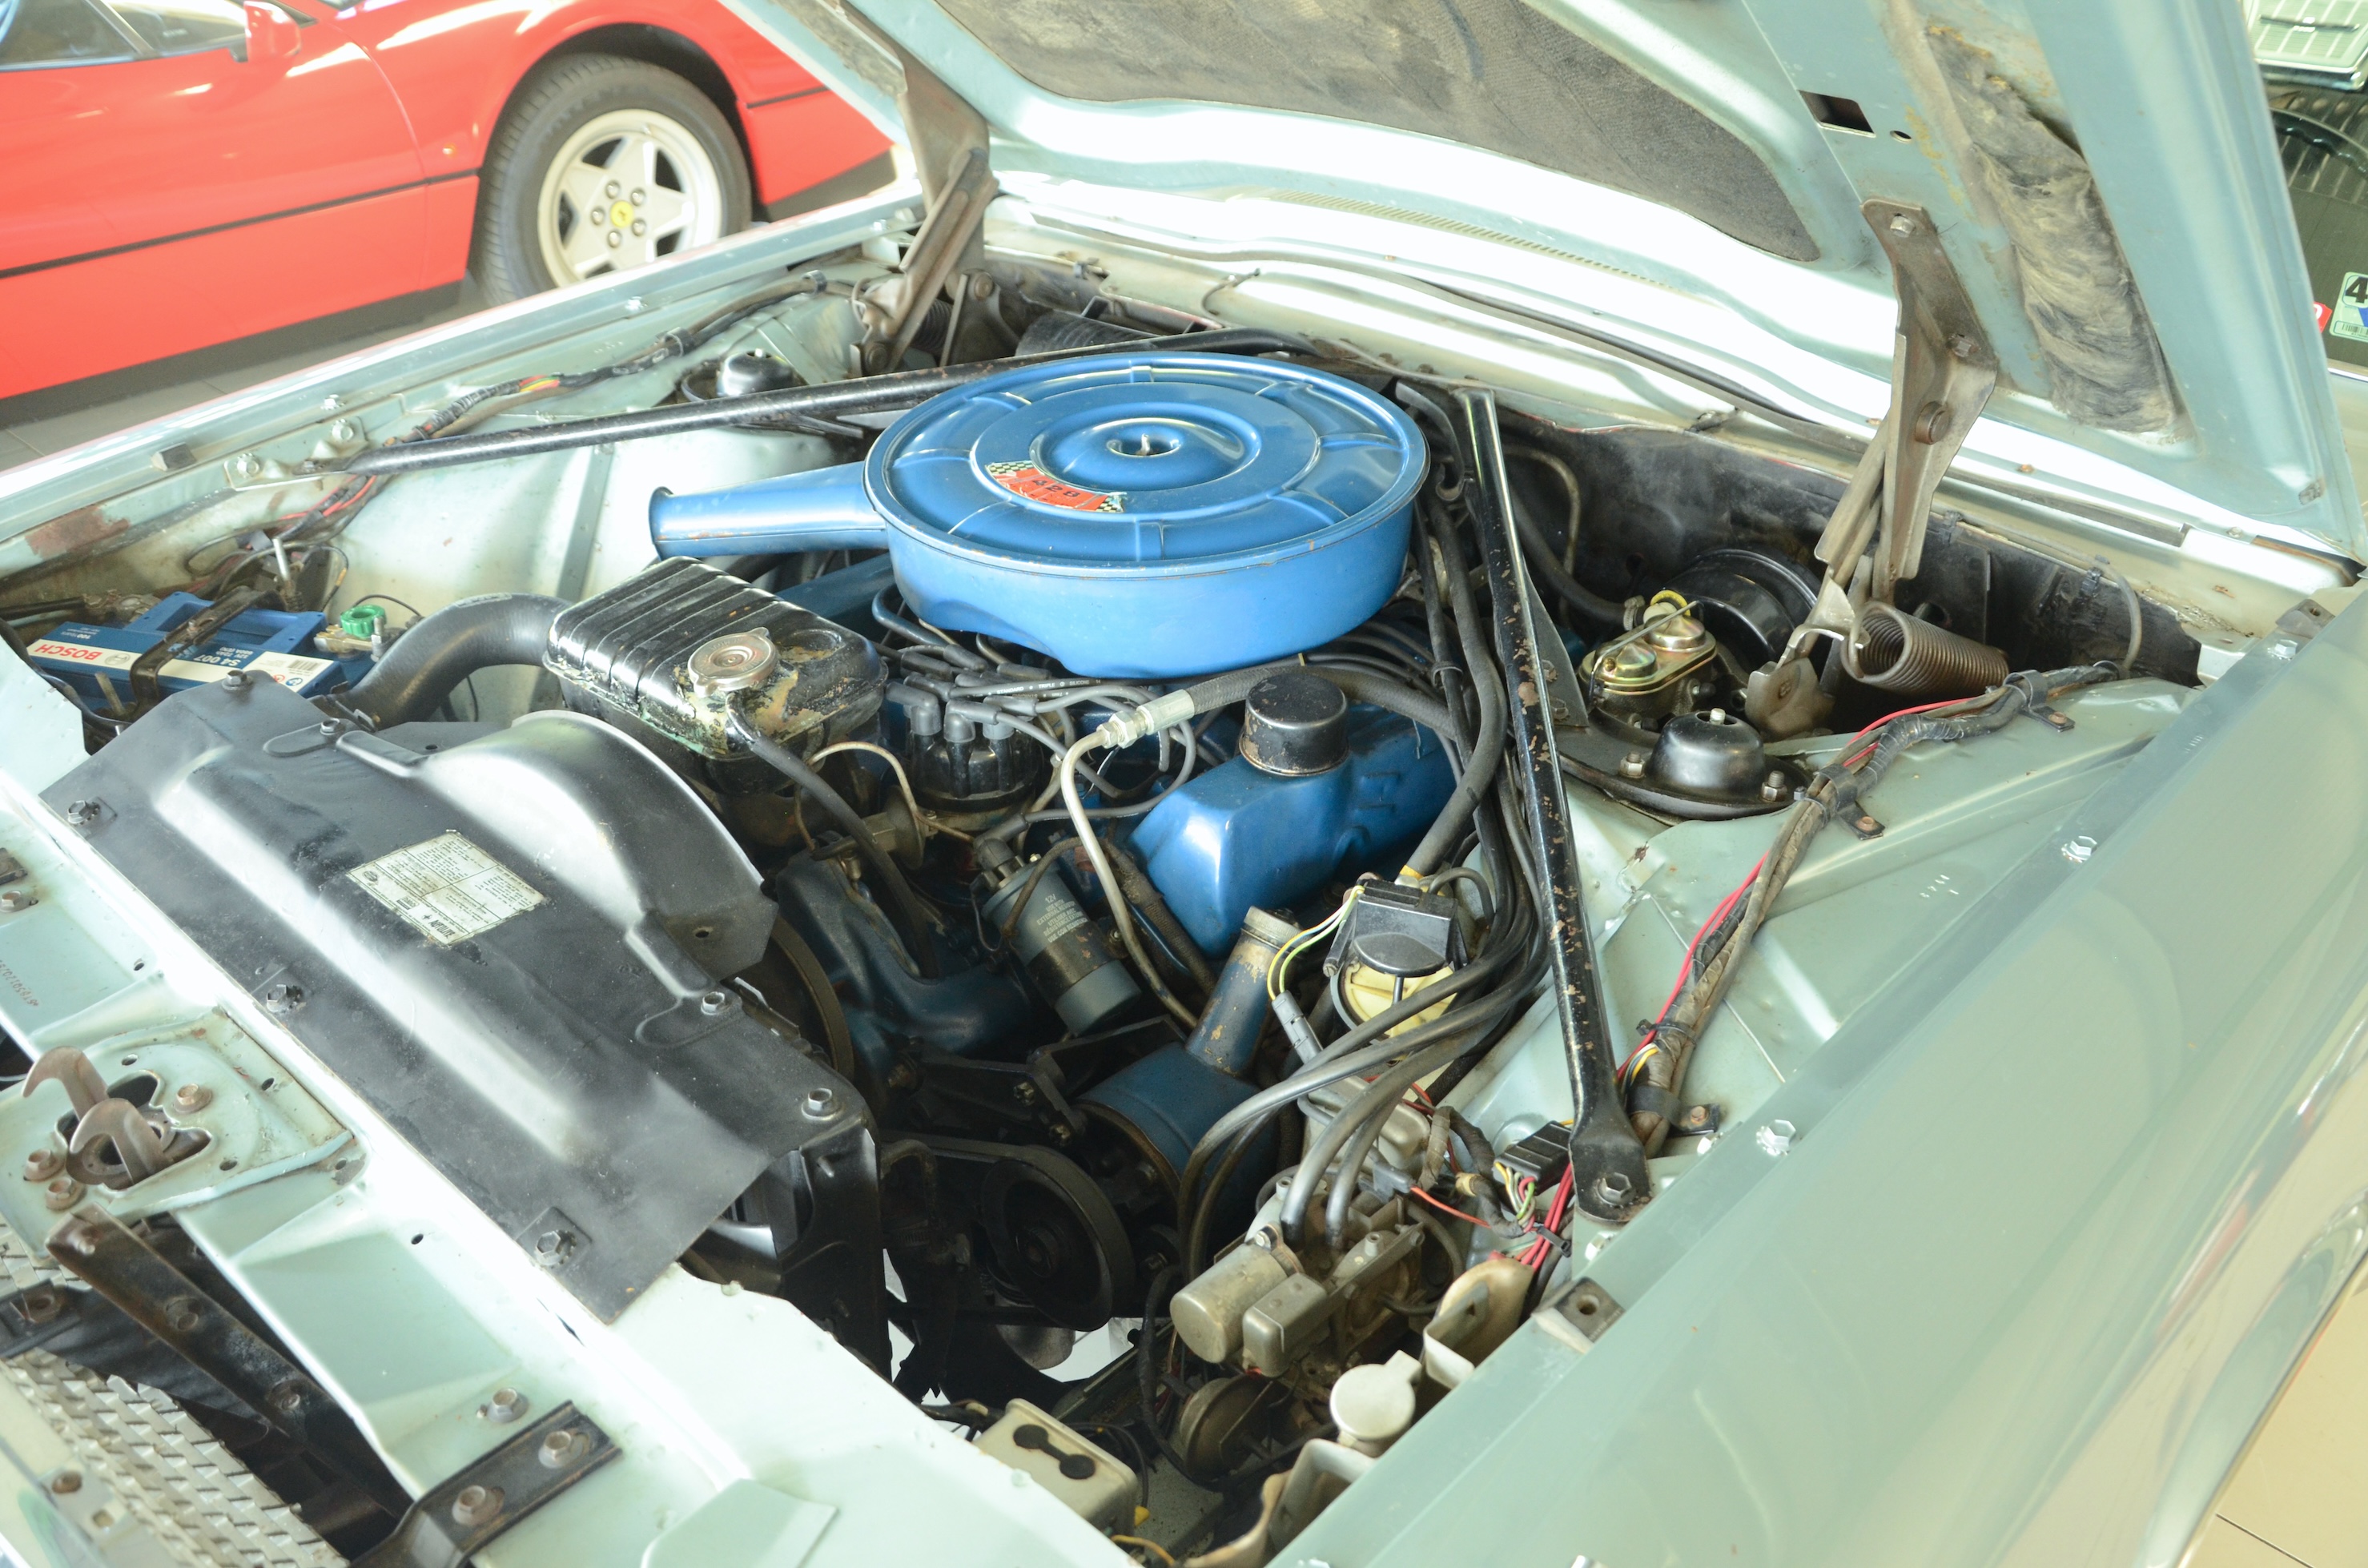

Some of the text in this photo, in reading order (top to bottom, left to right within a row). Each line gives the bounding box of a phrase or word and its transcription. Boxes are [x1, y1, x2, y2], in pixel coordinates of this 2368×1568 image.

[1032, 480, 1080, 497] 428
[34, 644, 103, 661] BOSCH
[193, 654, 242, 666] S4 007
[996, 686, 1024, 694] STANDARD
[1045, 894, 1056, 903] 12V
[1036, 907, 1060, 926] EXTERNAL
[428, 920, 456, 939] AUTOLITE
